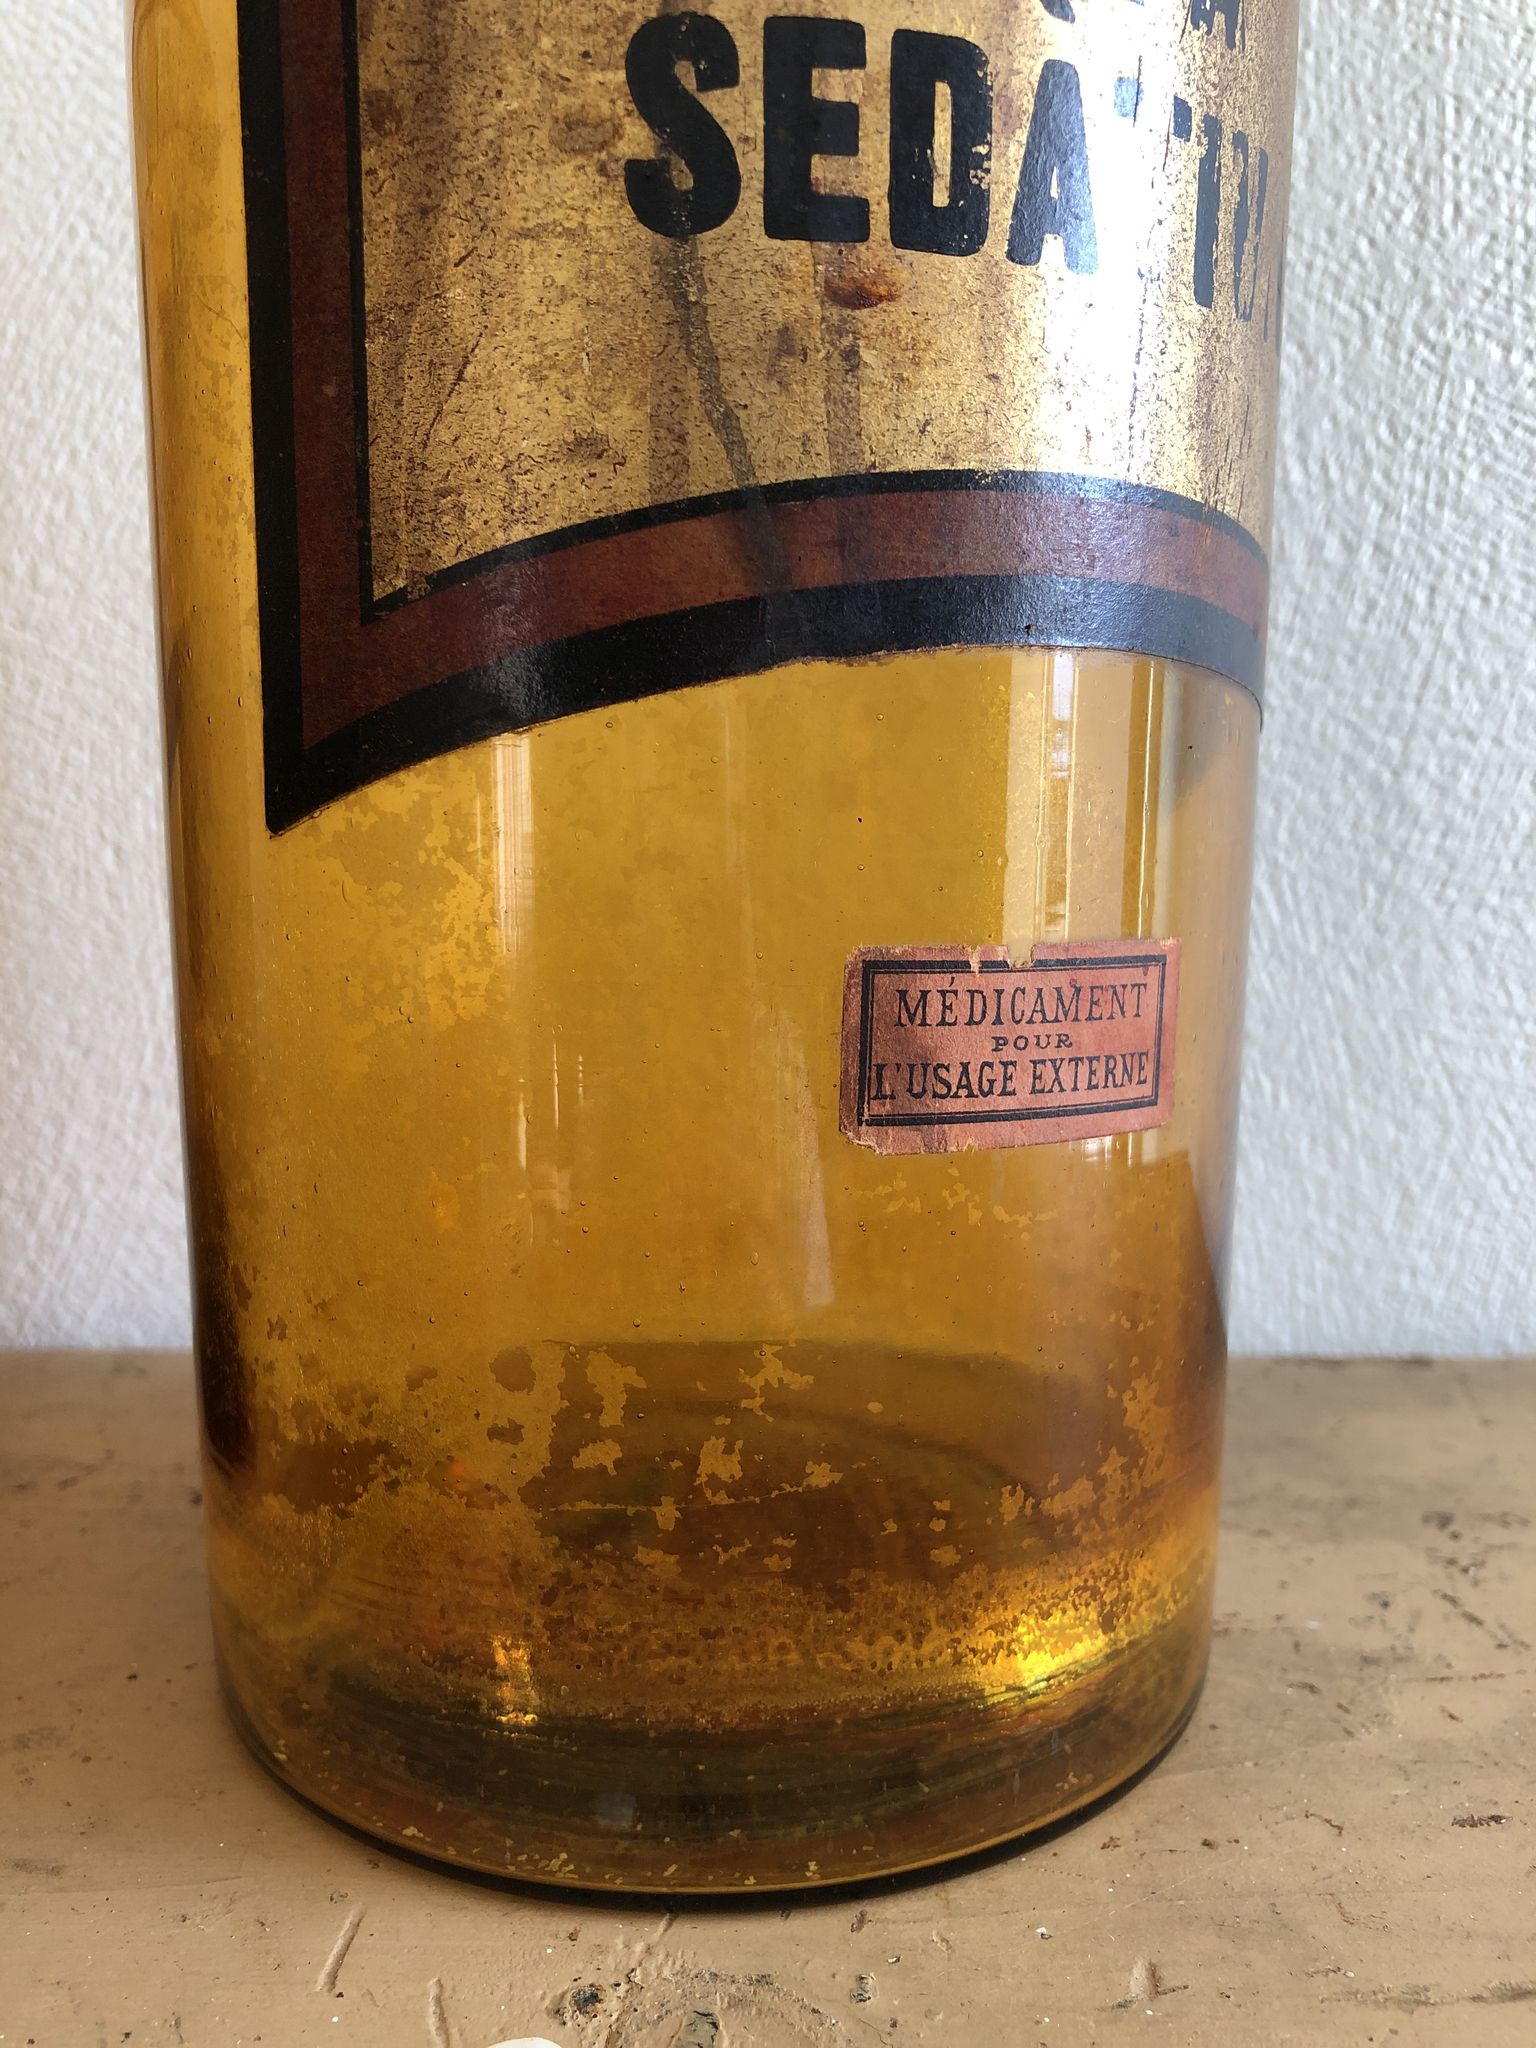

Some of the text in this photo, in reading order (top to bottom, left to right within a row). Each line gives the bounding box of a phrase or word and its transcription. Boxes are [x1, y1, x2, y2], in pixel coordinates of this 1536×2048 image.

[894, 976, 1148, 1028] MÉDICAMENT
[991, 1033, 1073, 1053] POUR
[870, 1050, 1150, 1101] L'USAGE EXTERNE
